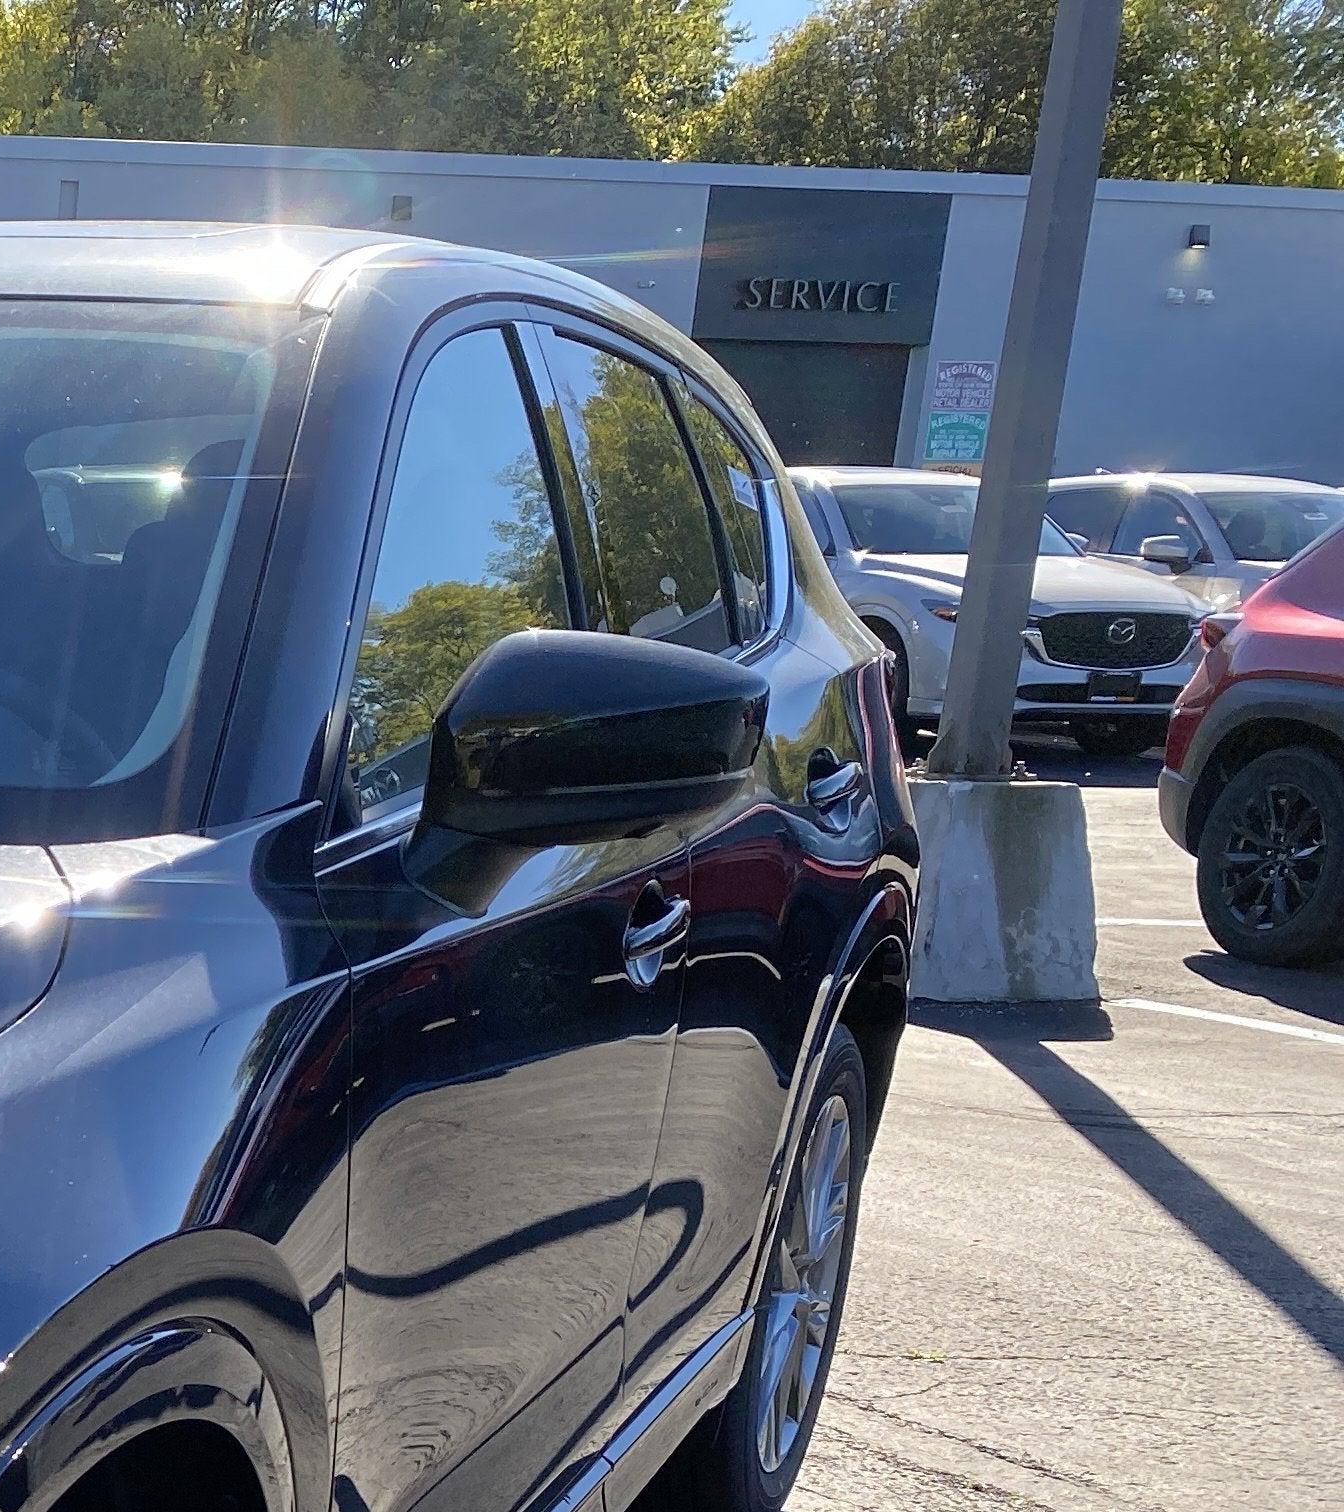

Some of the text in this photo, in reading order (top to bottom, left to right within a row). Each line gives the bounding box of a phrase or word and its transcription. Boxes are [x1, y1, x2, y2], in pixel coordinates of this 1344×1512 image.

[745, 276, 901, 313] SERVICE
[939, 363, 993, 382] REGISTERED
[962, 389, 993, 400] VEHICLE
[933, 398, 958, 407] RETAIL
[931, 414, 986, 430] REGISTERED
[932, 465, 972, 476] FFICIAL
